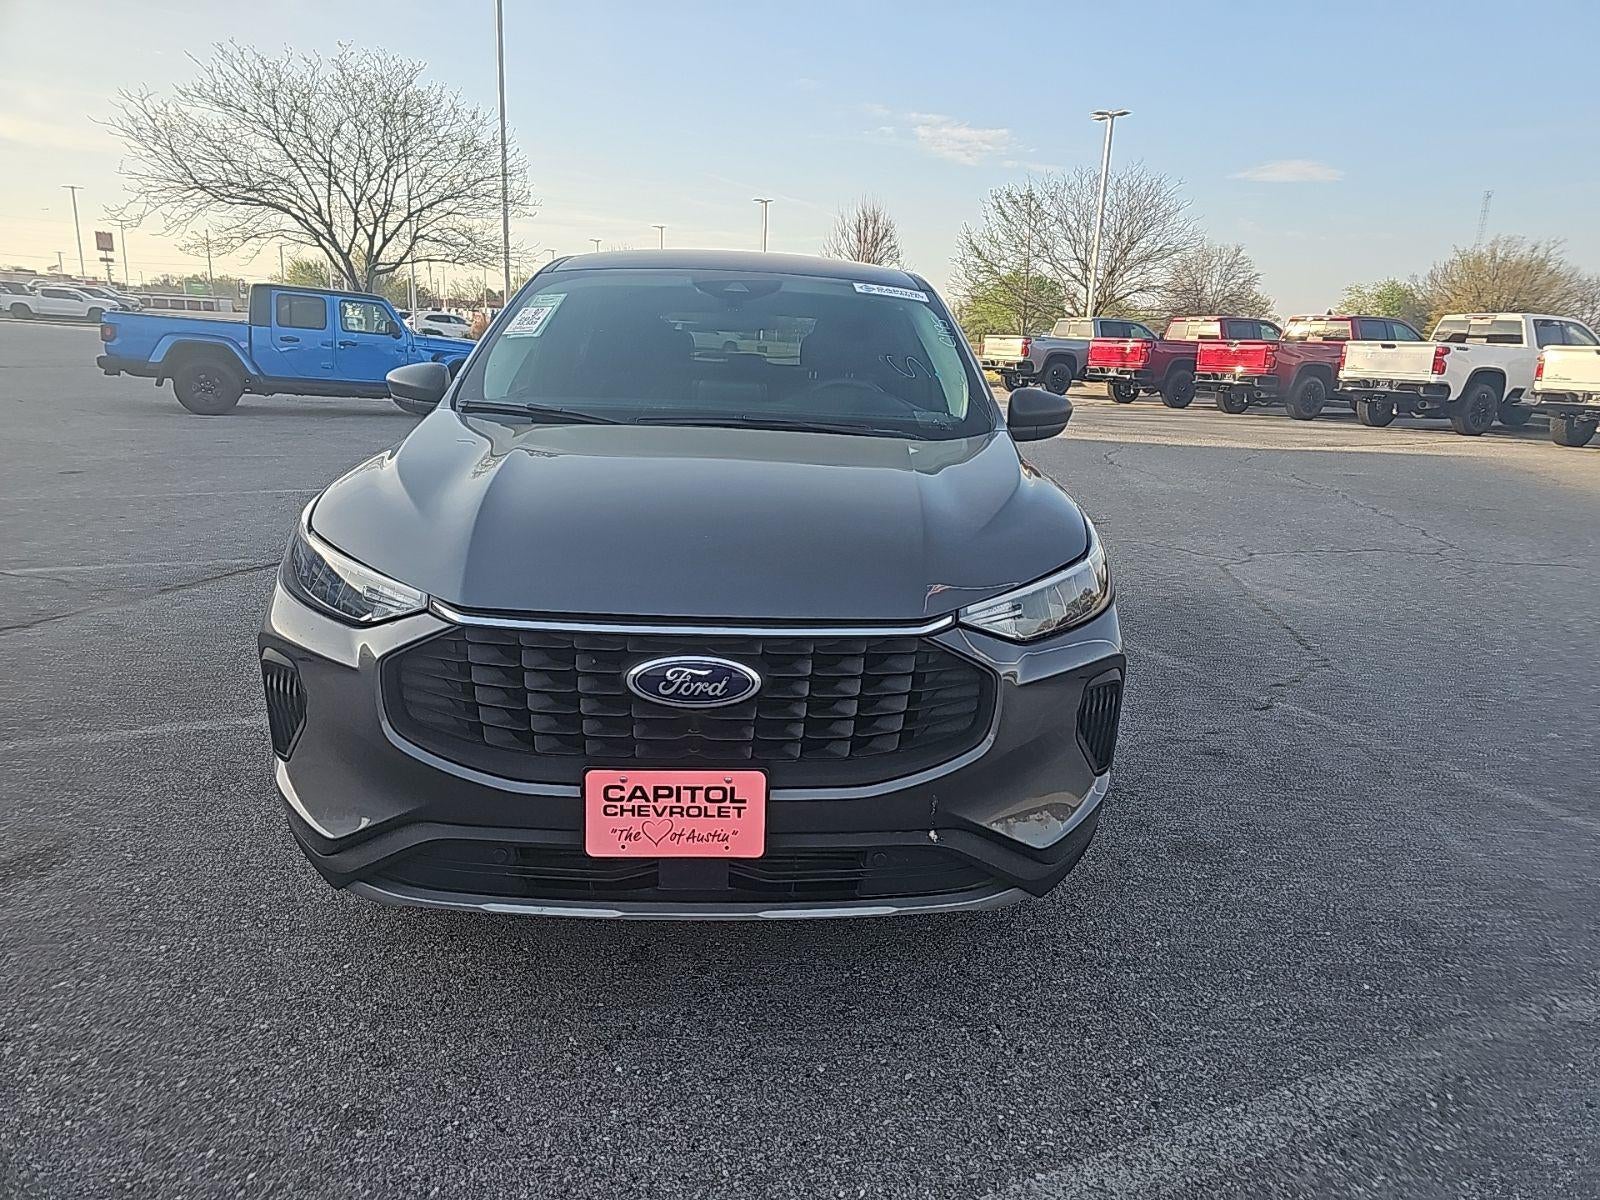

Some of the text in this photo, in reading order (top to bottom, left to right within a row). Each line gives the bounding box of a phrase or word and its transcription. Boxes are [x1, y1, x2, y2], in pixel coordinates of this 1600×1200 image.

[658, 667, 730, 697] Ford
[602, 784, 748, 804] CAPITOL
[602, 804, 747, 818] CHEVROLET
[610, 826, 642, 843] "The
[669, 828, 686, 845] of
